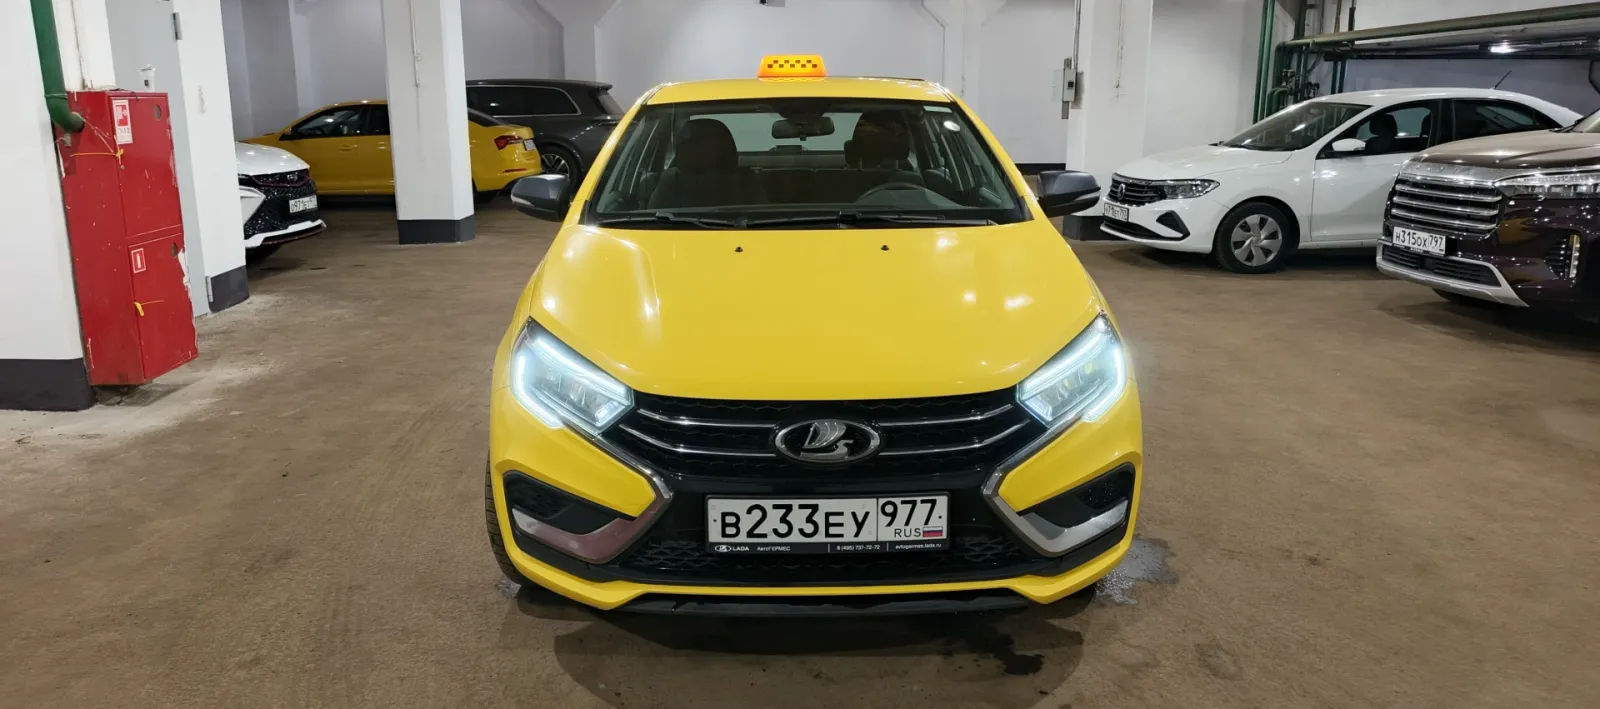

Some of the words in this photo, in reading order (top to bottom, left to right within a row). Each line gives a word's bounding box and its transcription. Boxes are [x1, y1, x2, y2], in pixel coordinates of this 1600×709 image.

[1395, 230, 1428, 249] Н315ОХ
[1429, 235, 1443, 248] 797
[720, 503, 870, 539] В233ЕУ
[880, 499, 938, 528] 977
[894, 528, 922, 538] RUS
